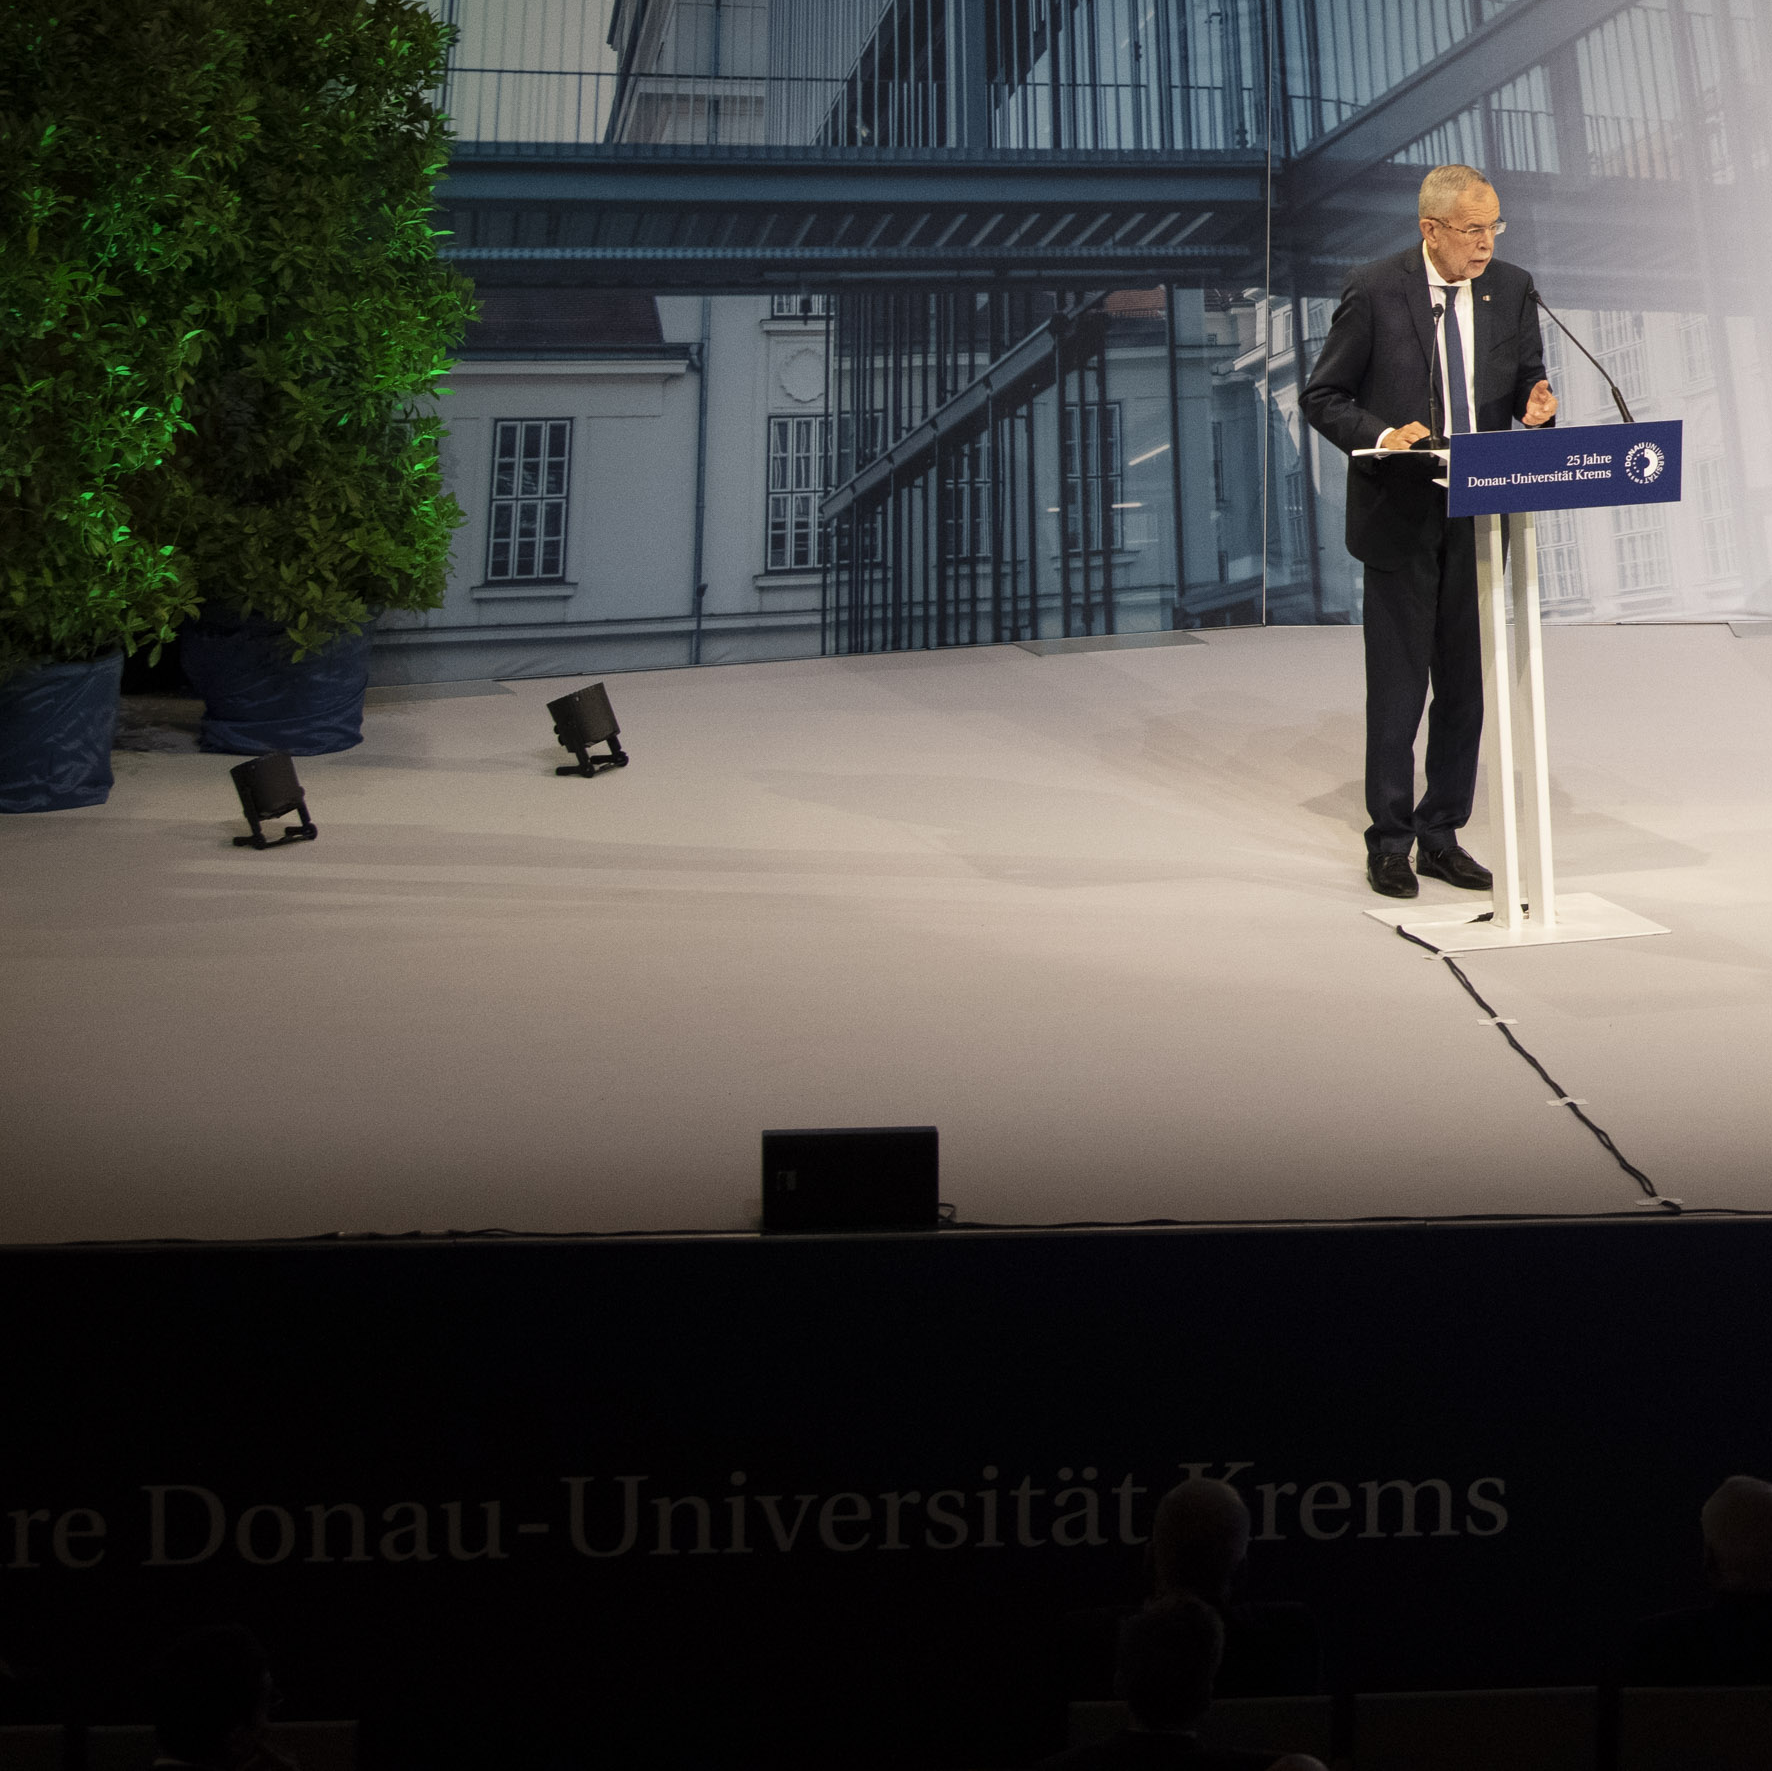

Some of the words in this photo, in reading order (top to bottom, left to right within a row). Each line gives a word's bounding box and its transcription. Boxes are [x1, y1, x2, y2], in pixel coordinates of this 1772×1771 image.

[1566, 454, 1581, 467] 25
[1582, 453, 1612, 466] Jahre
[1467, 470, 1573, 488] Donau-Universität
[1575, 469, 1612, 481] Krems
[0, 1507, 107, 1569] re
[139, 1465, 1149, 1568] Donau-Universität
[1178, 1461, 1509, 1542] rems
